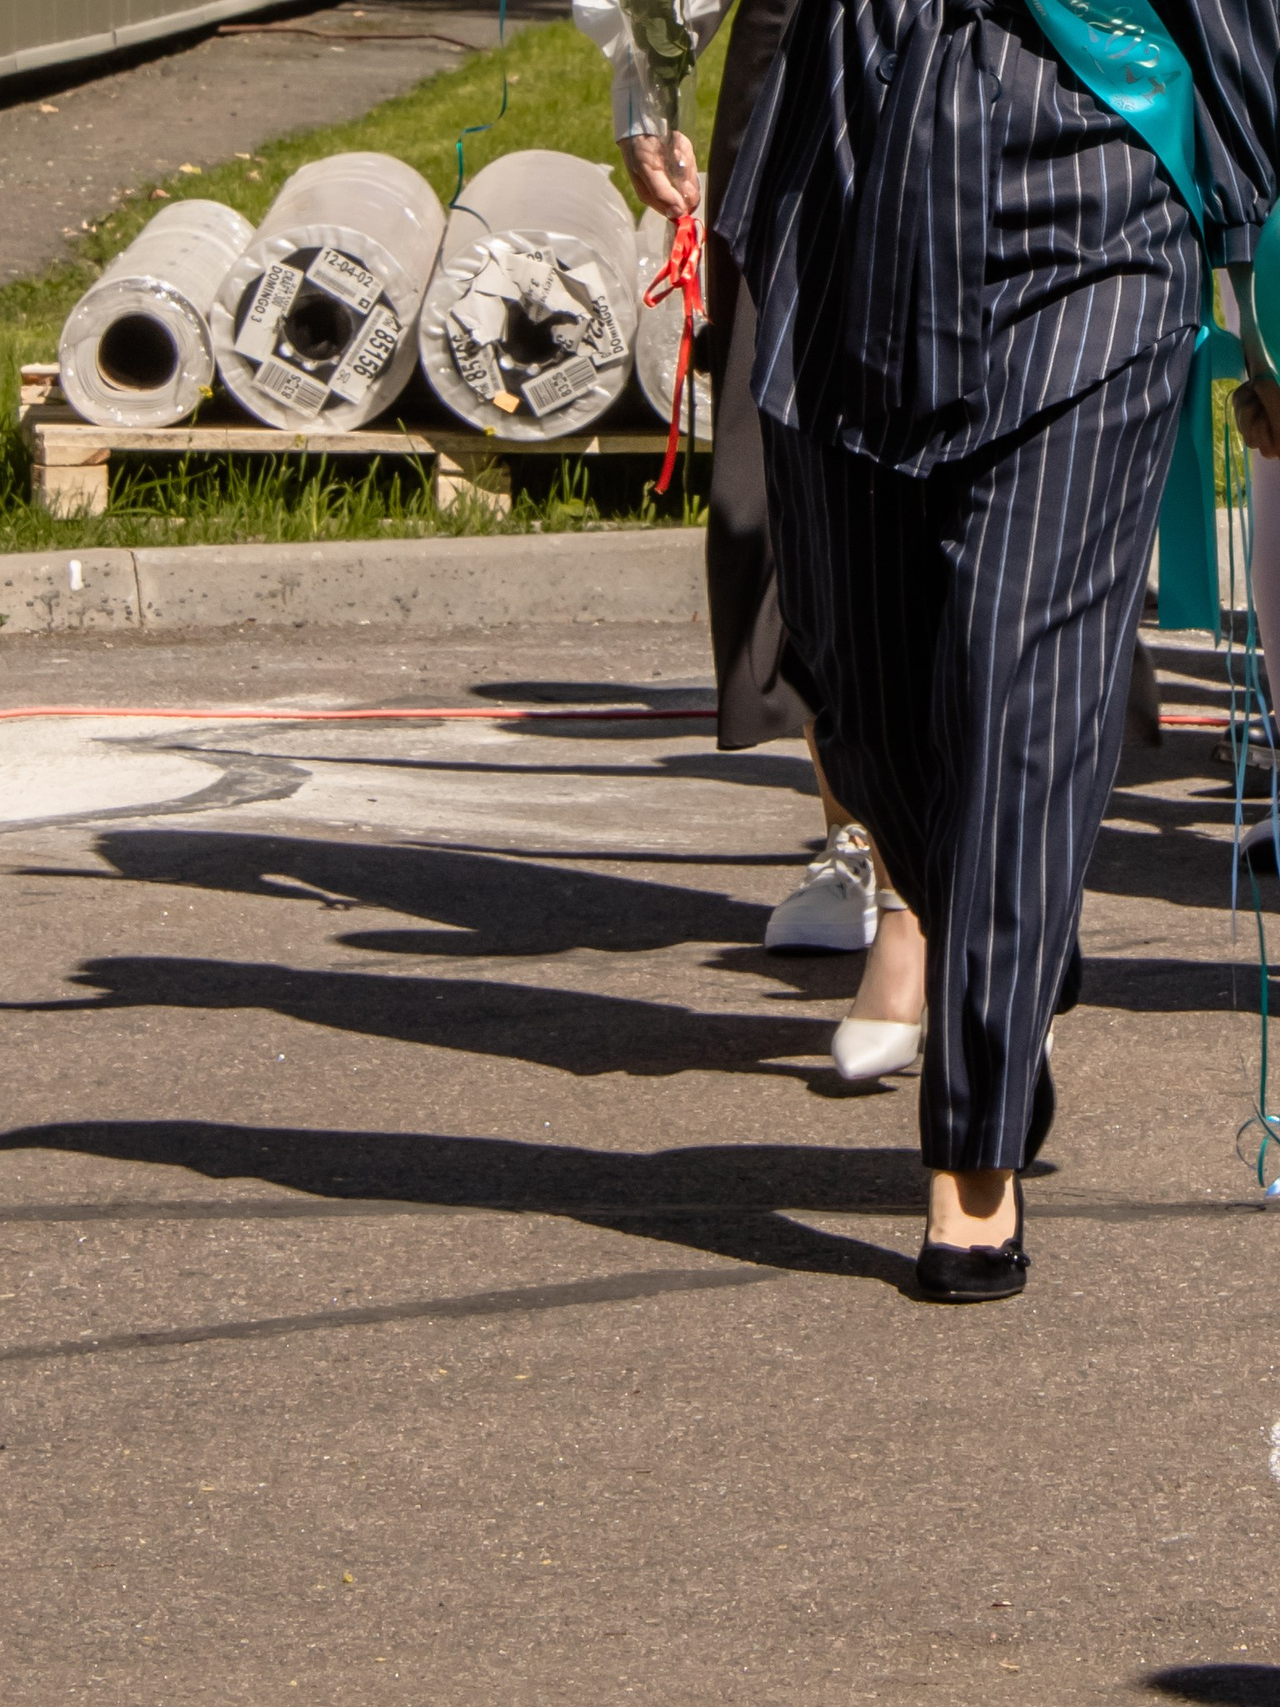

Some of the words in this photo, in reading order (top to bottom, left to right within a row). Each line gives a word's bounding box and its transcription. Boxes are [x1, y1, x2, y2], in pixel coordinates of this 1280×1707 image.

[255, 265, 283, 314] DOMINGO
[323, 250, 374, 288] 12-04-02
[250, 315, 262, 324] 3
[353, 328, 396, 380] 85156
